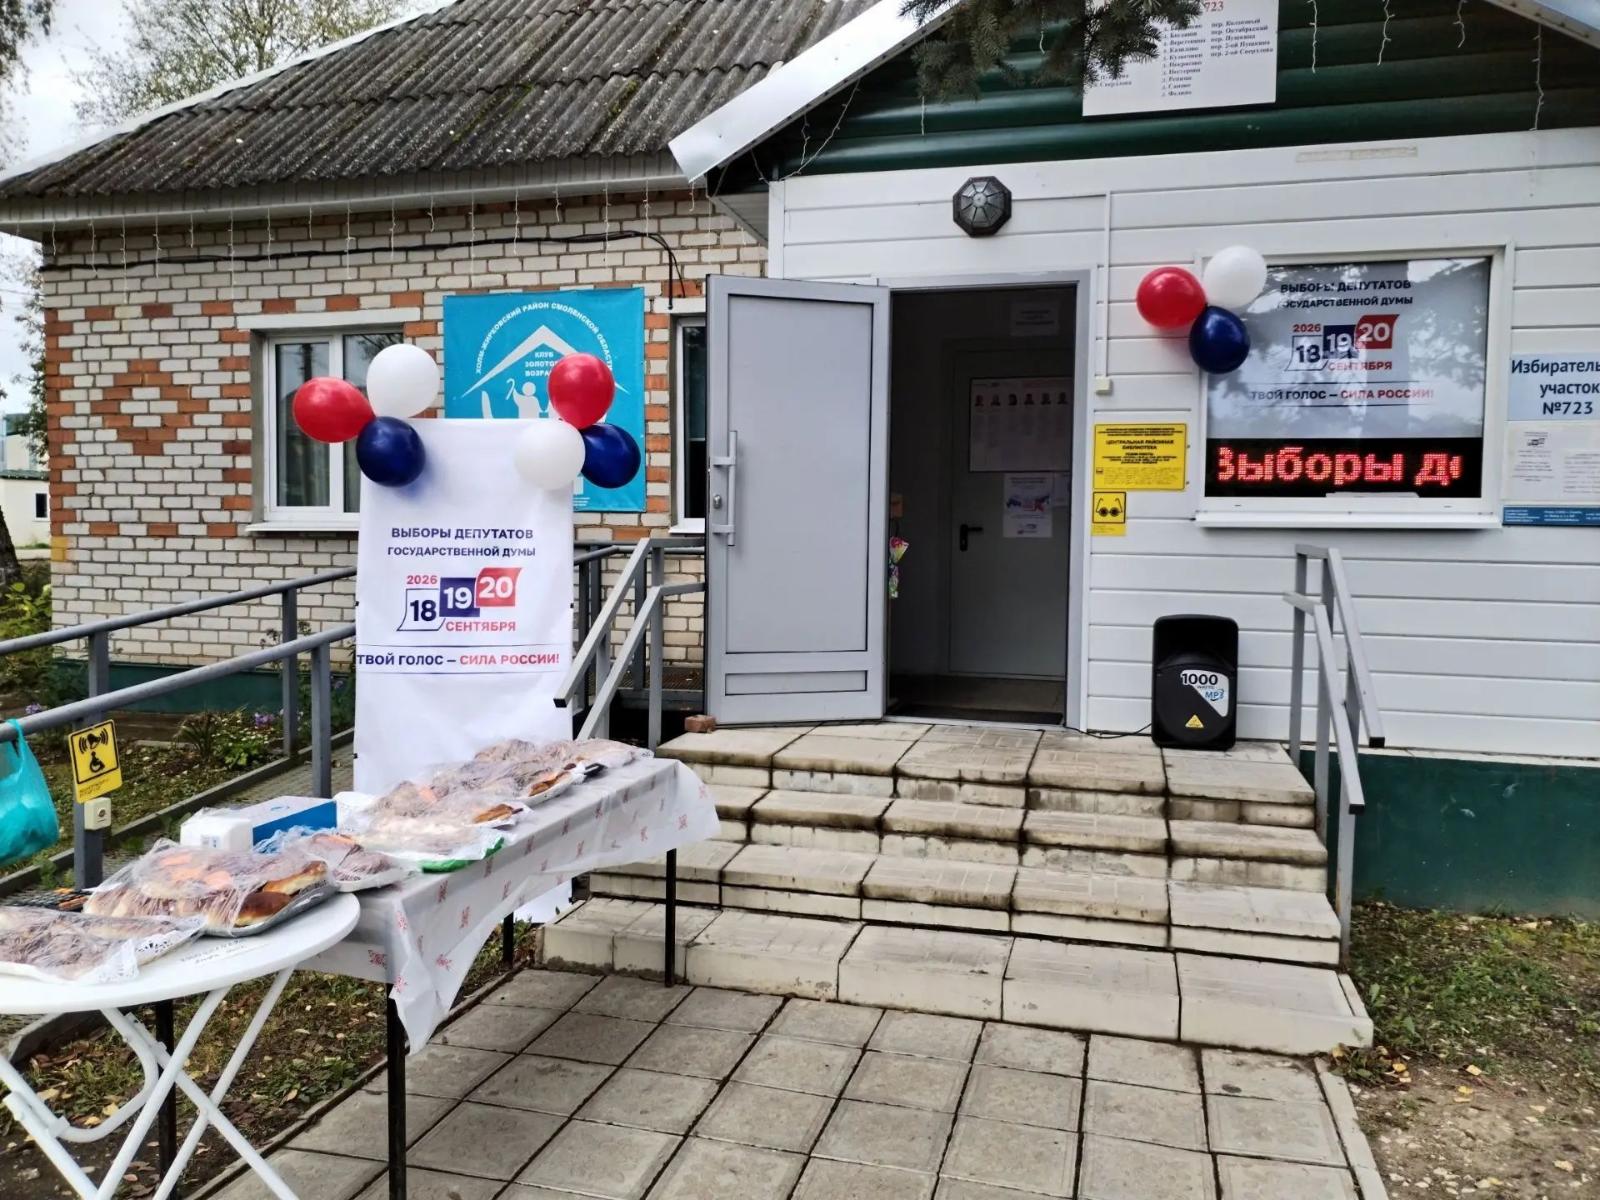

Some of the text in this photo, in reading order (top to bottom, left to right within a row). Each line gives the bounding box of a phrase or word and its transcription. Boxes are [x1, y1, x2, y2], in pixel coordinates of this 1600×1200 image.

[1204, 2, 1223, 12] 723
[1280, 280, 1411, 293] ВЫБОРЫ ДЕПУТАТОВ
[1380, 297, 1413, 306] ДУМЫ
[1293, 324, 1321, 332] 2026
[476, 307, 521, 374] ХОЛМ-ЖИРКОВСКИЙ
[522, 302, 549, 312] РАЙОН
[551, 303, 599, 334] СМОЛЕНСКОЙ
[1296, 322, 1390, 363] 18 19 20
[1328, 361, 1392, 371] СЕНТЯБРЯ
[1251, 389, 1283, 400] ТВОЙ
[1286, 390, 1327, 399] ГОЛОС
[1340, 390, 1374, 399] СИЛА
[1540, 383, 1600, 398] участок
[1543, 401, 1593, 415] №723
[391, 528, 534, 540] ВЫБОРЫ ДЕПУТАТОВ
[387, 546, 536, 557] ГОСУДАРСТВЕННОЙ ДУМЫ
[406, 575, 438, 585] 2026
[410, 576, 514, 621] 18 19 20
[445, 621, 516, 631] СЕНТЯБРЯ
[357, 653, 394, 665] ТВОЙ
[399, 654, 443, 665] ГОЛОС
[459, 655, 497, 665] СИЛА
[501, 654, 559, 665] РОССИИ!
[1182, 673, 1218, 685] 1000
[1205, 689, 1224, 699] MP3
